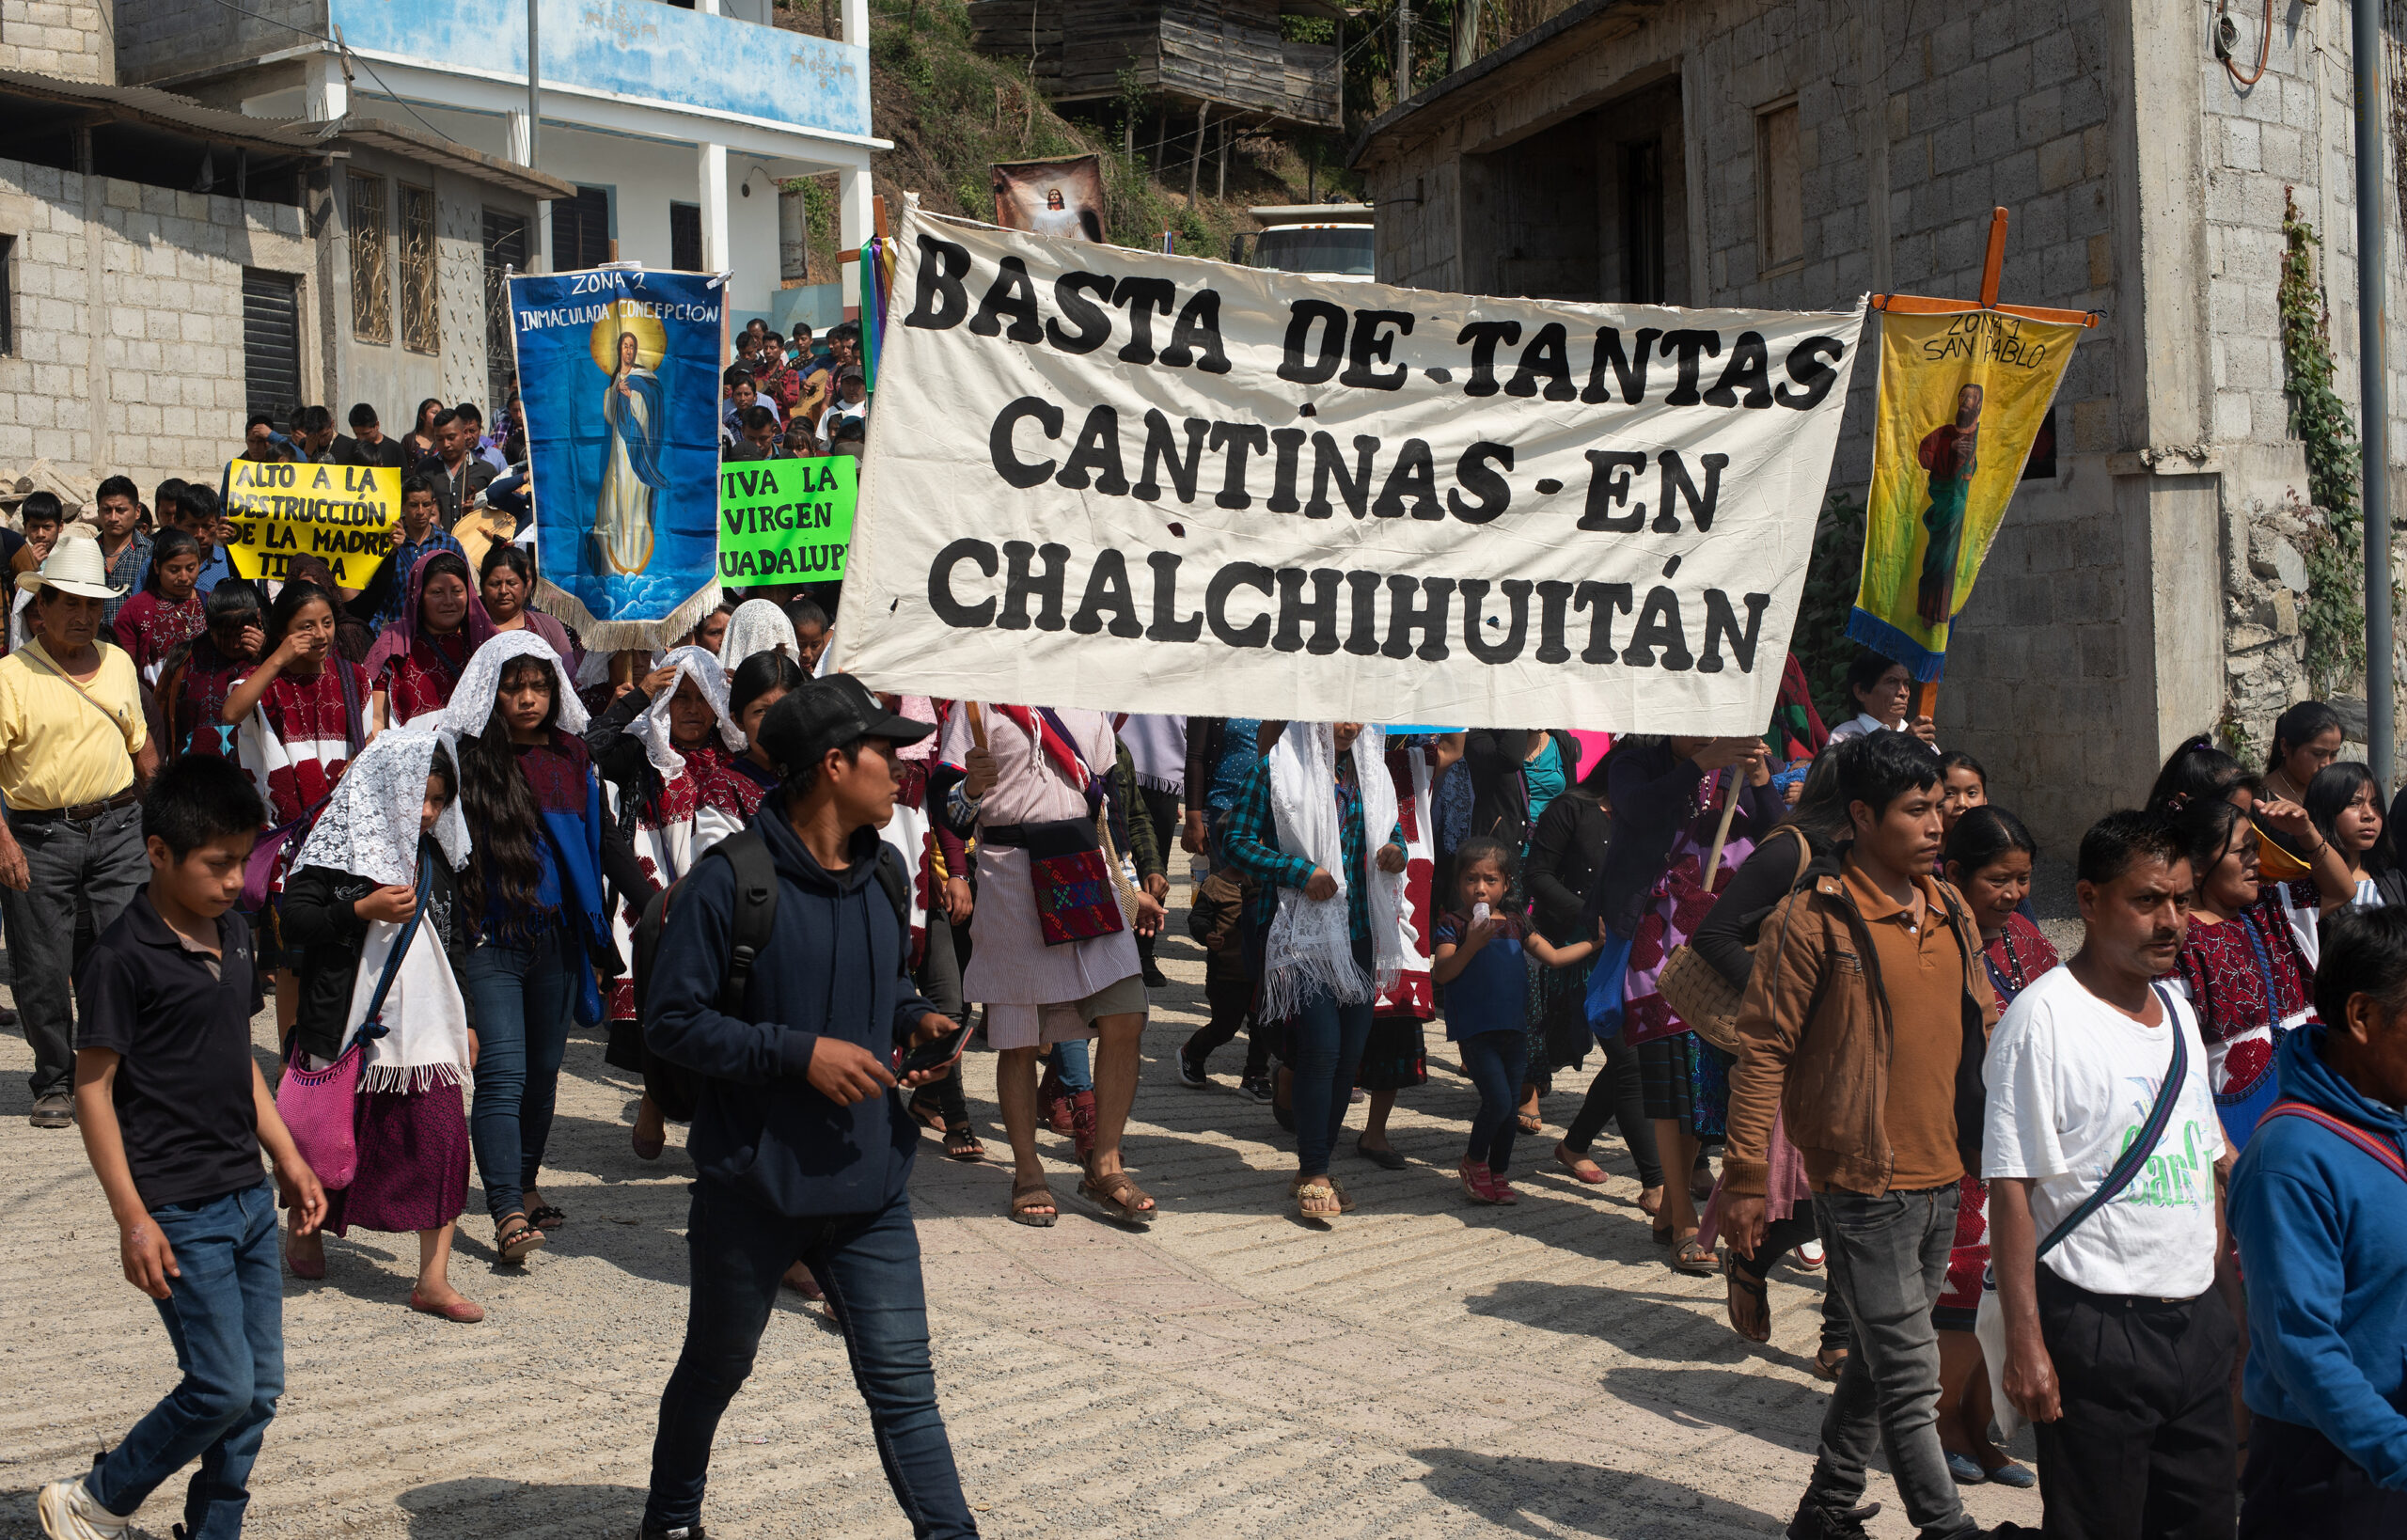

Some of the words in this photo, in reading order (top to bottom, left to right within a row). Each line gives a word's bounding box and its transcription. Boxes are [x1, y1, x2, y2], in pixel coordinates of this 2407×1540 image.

[571, 271, 625, 295] ZONA
[633, 272, 646, 290] 2
[519, 303, 610, 331] INMACULADA
[618, 300, 719, 322] CONCEPCIÓN
[905, 234, 1232, 375] BASTA
[1277, 300, 1415, 391] DE
[1457, 320, 1845, 411] TANTAS
[1947, 311, 2003, 336] ZONA
[2007, 320, 2021, 339] 1
[1923, 337, 1974, 360] SAN
[1984, 336, 2046, 369] PABLO
[236, 463, 296, 488] ALTO
[312, 466, 331, 489] A
[345, 466, 378, 493] LA
[990, 397, 1515, 525] CANTINAS
[1577, 449, 1729, 533] EN
[720, 470, 779, 498] IVA
[802, 466, 838, 493] LA
[228, 492, 386, 526] DESTRUCCIÓN
[723, 502, 833, 535] VIRGEN
[227, 522, 256, 545] DE
[266, 523, 297, 549] LA
[312, 527, 392, 558] MADRE
[258, 552, 346, 580] TIA
[719, 543, 848, 577] UADALUP
[928, 539, 1770, 674] CHALCHIHUITÁN
